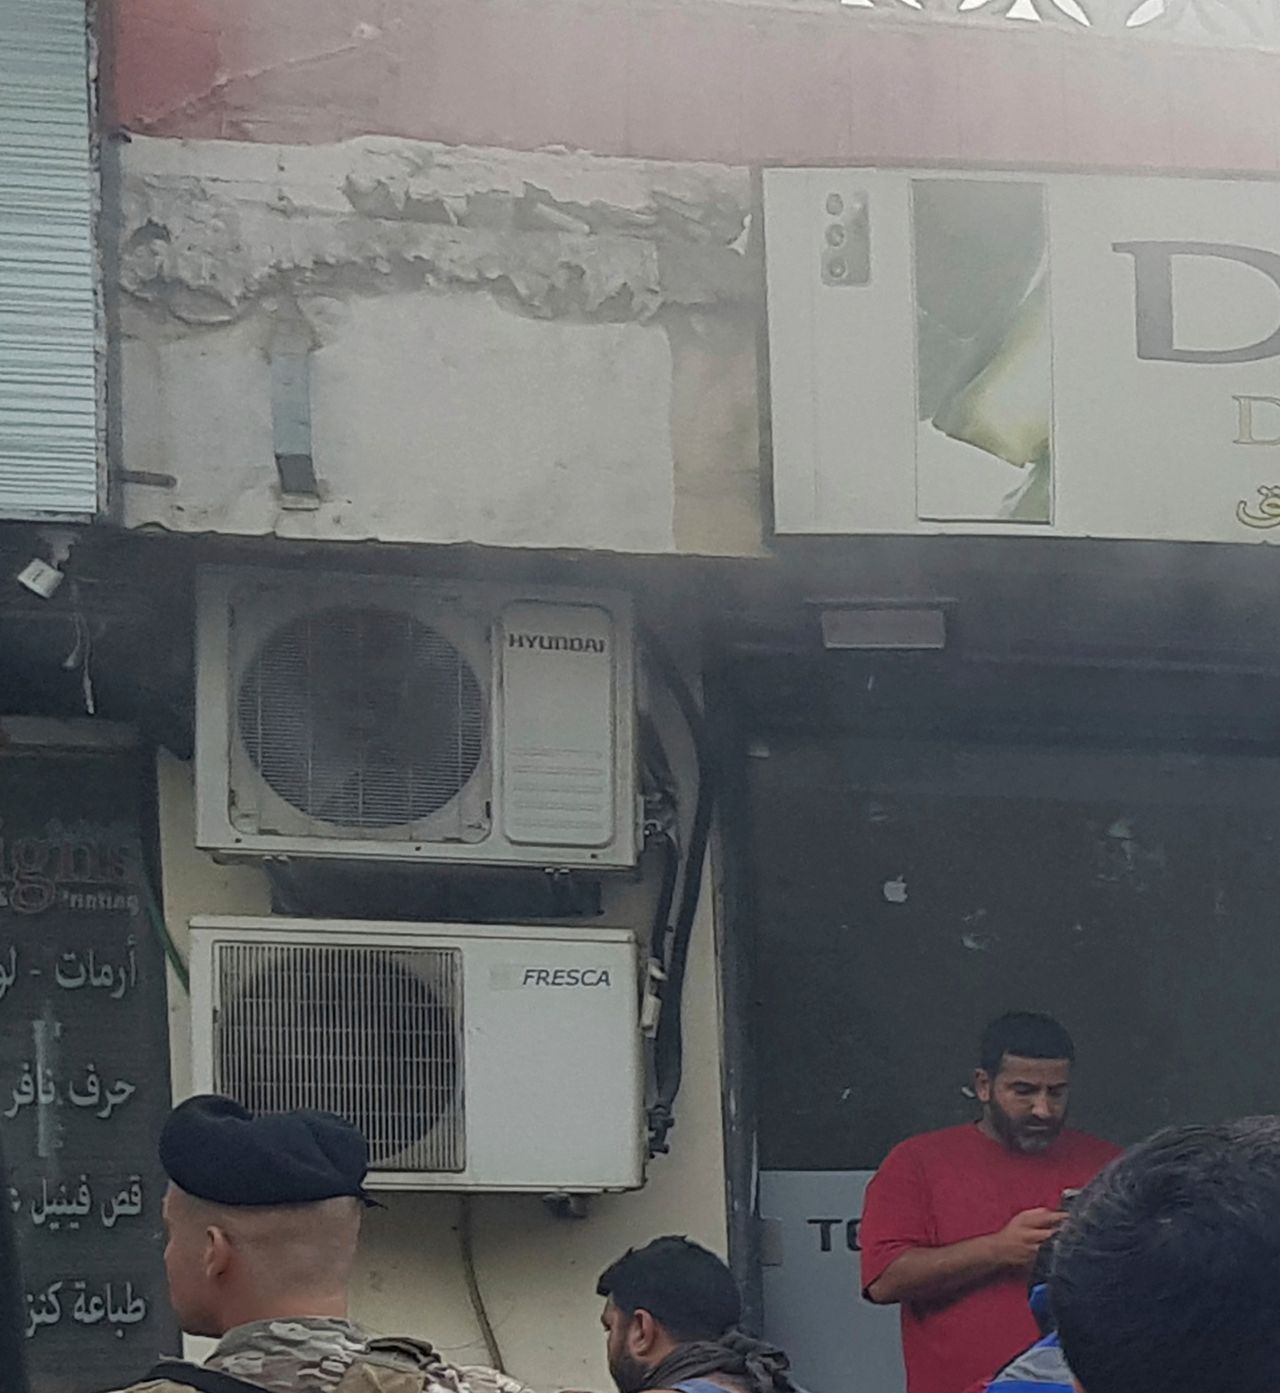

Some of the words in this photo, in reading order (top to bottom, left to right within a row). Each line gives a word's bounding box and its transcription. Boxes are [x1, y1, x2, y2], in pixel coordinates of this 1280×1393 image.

[508, 633, 605, 653] HYUNDAI
[55, 934, 138, 999] أرمات
[522, 968, 611, 987] FRESCA
[69, 1062, 137, 1119] حرف
[31, 1173, 92, 1230] فينيل
[101, 1173, 143, 1228] قص
[73, 1280, 146, 1338] طباعة
